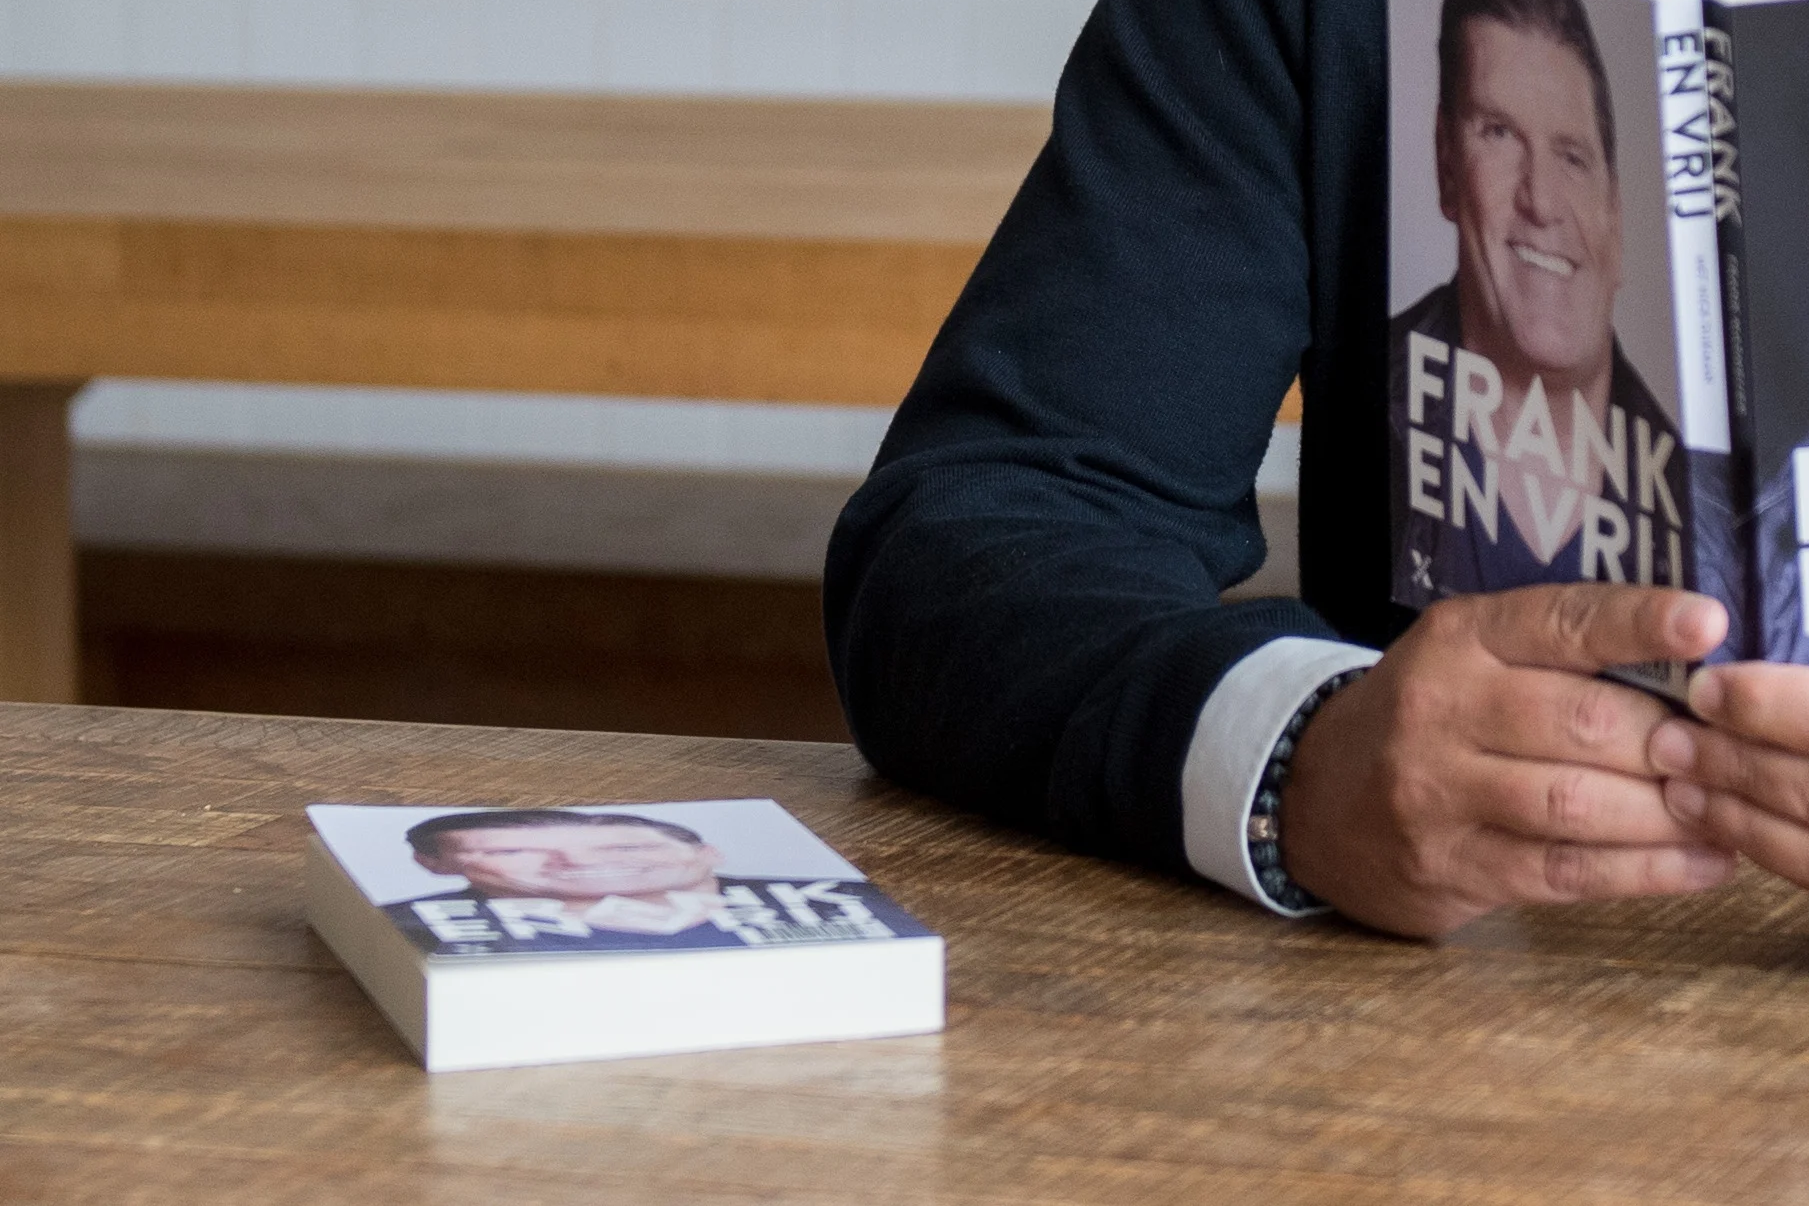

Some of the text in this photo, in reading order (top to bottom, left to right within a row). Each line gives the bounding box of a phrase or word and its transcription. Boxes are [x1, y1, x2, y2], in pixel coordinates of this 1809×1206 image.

[1662, 32, 1705, 96] EN
[1671, 110, 1714, 220] VRIJ
[1704, 26, 1743, 229] FRANK
[1409, 330, 1682, 529] FRANK
[1409, 426, 1499, 545] EN
